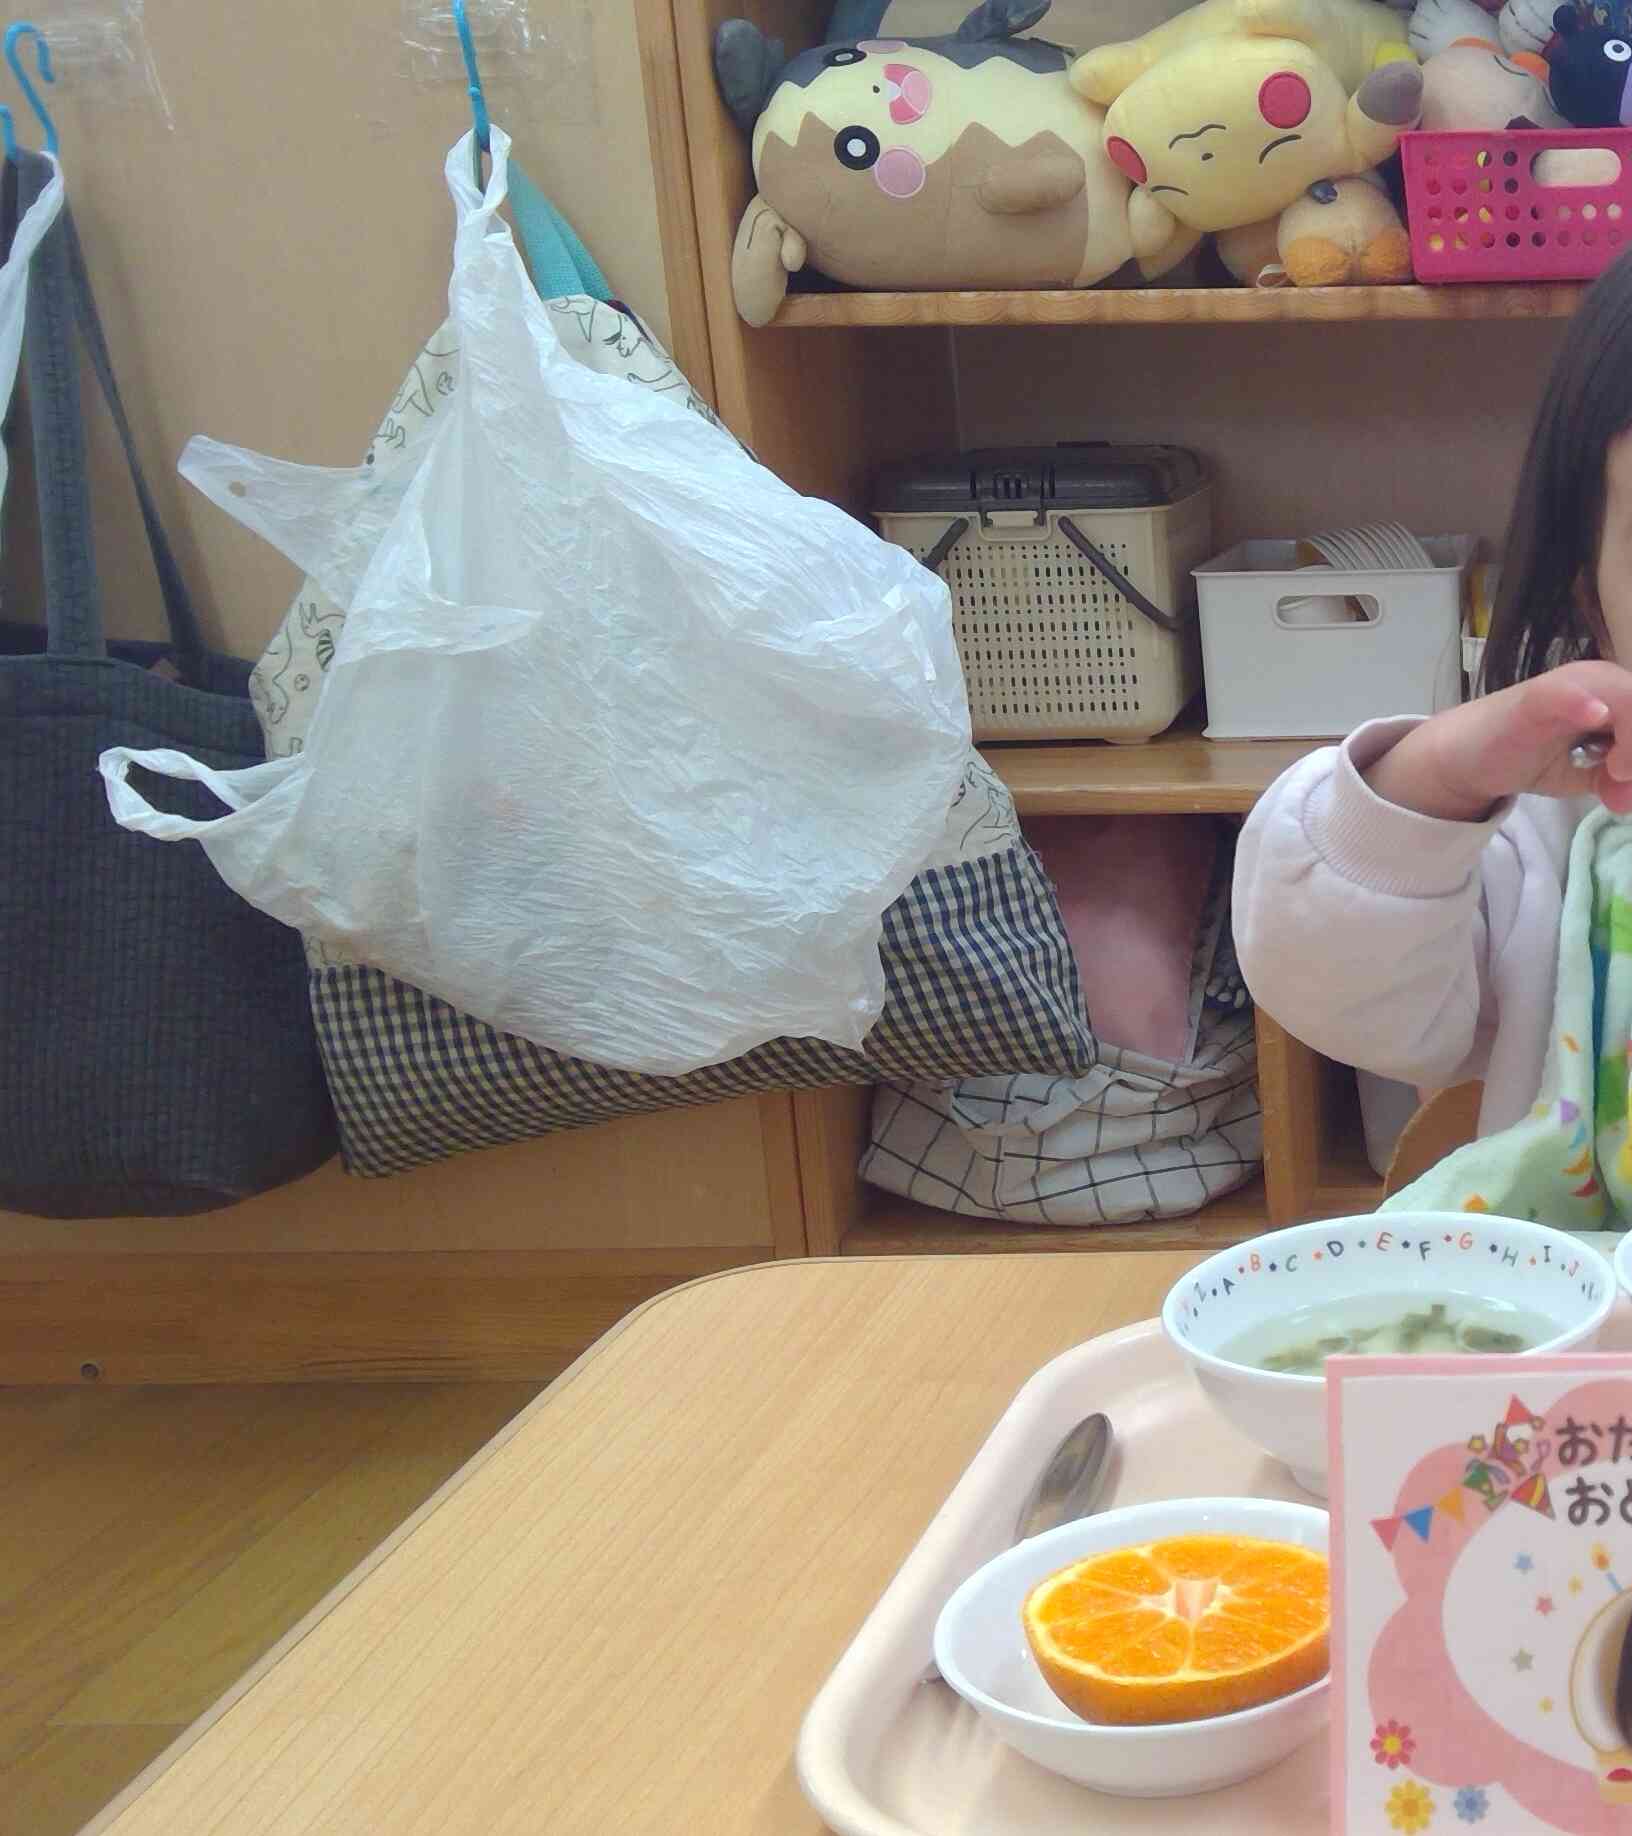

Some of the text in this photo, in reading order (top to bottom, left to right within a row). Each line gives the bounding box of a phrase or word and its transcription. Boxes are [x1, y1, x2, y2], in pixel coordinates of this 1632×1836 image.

[1222, 1277, 1236, 1296] A
[1249, 1252, 1261, 1272] B
[1285, 1254, 1298, 1272] C
[1326, 1240, 1345, 1257] D
[1376, 1231, 1393, 1251] E
[1418, 1241, 1431, 1261] F
[1458, 1232, 1473, 1250] G
[1502, 1246, 1519, 1268] H
[1543, 1245, 1552, 1263] I
